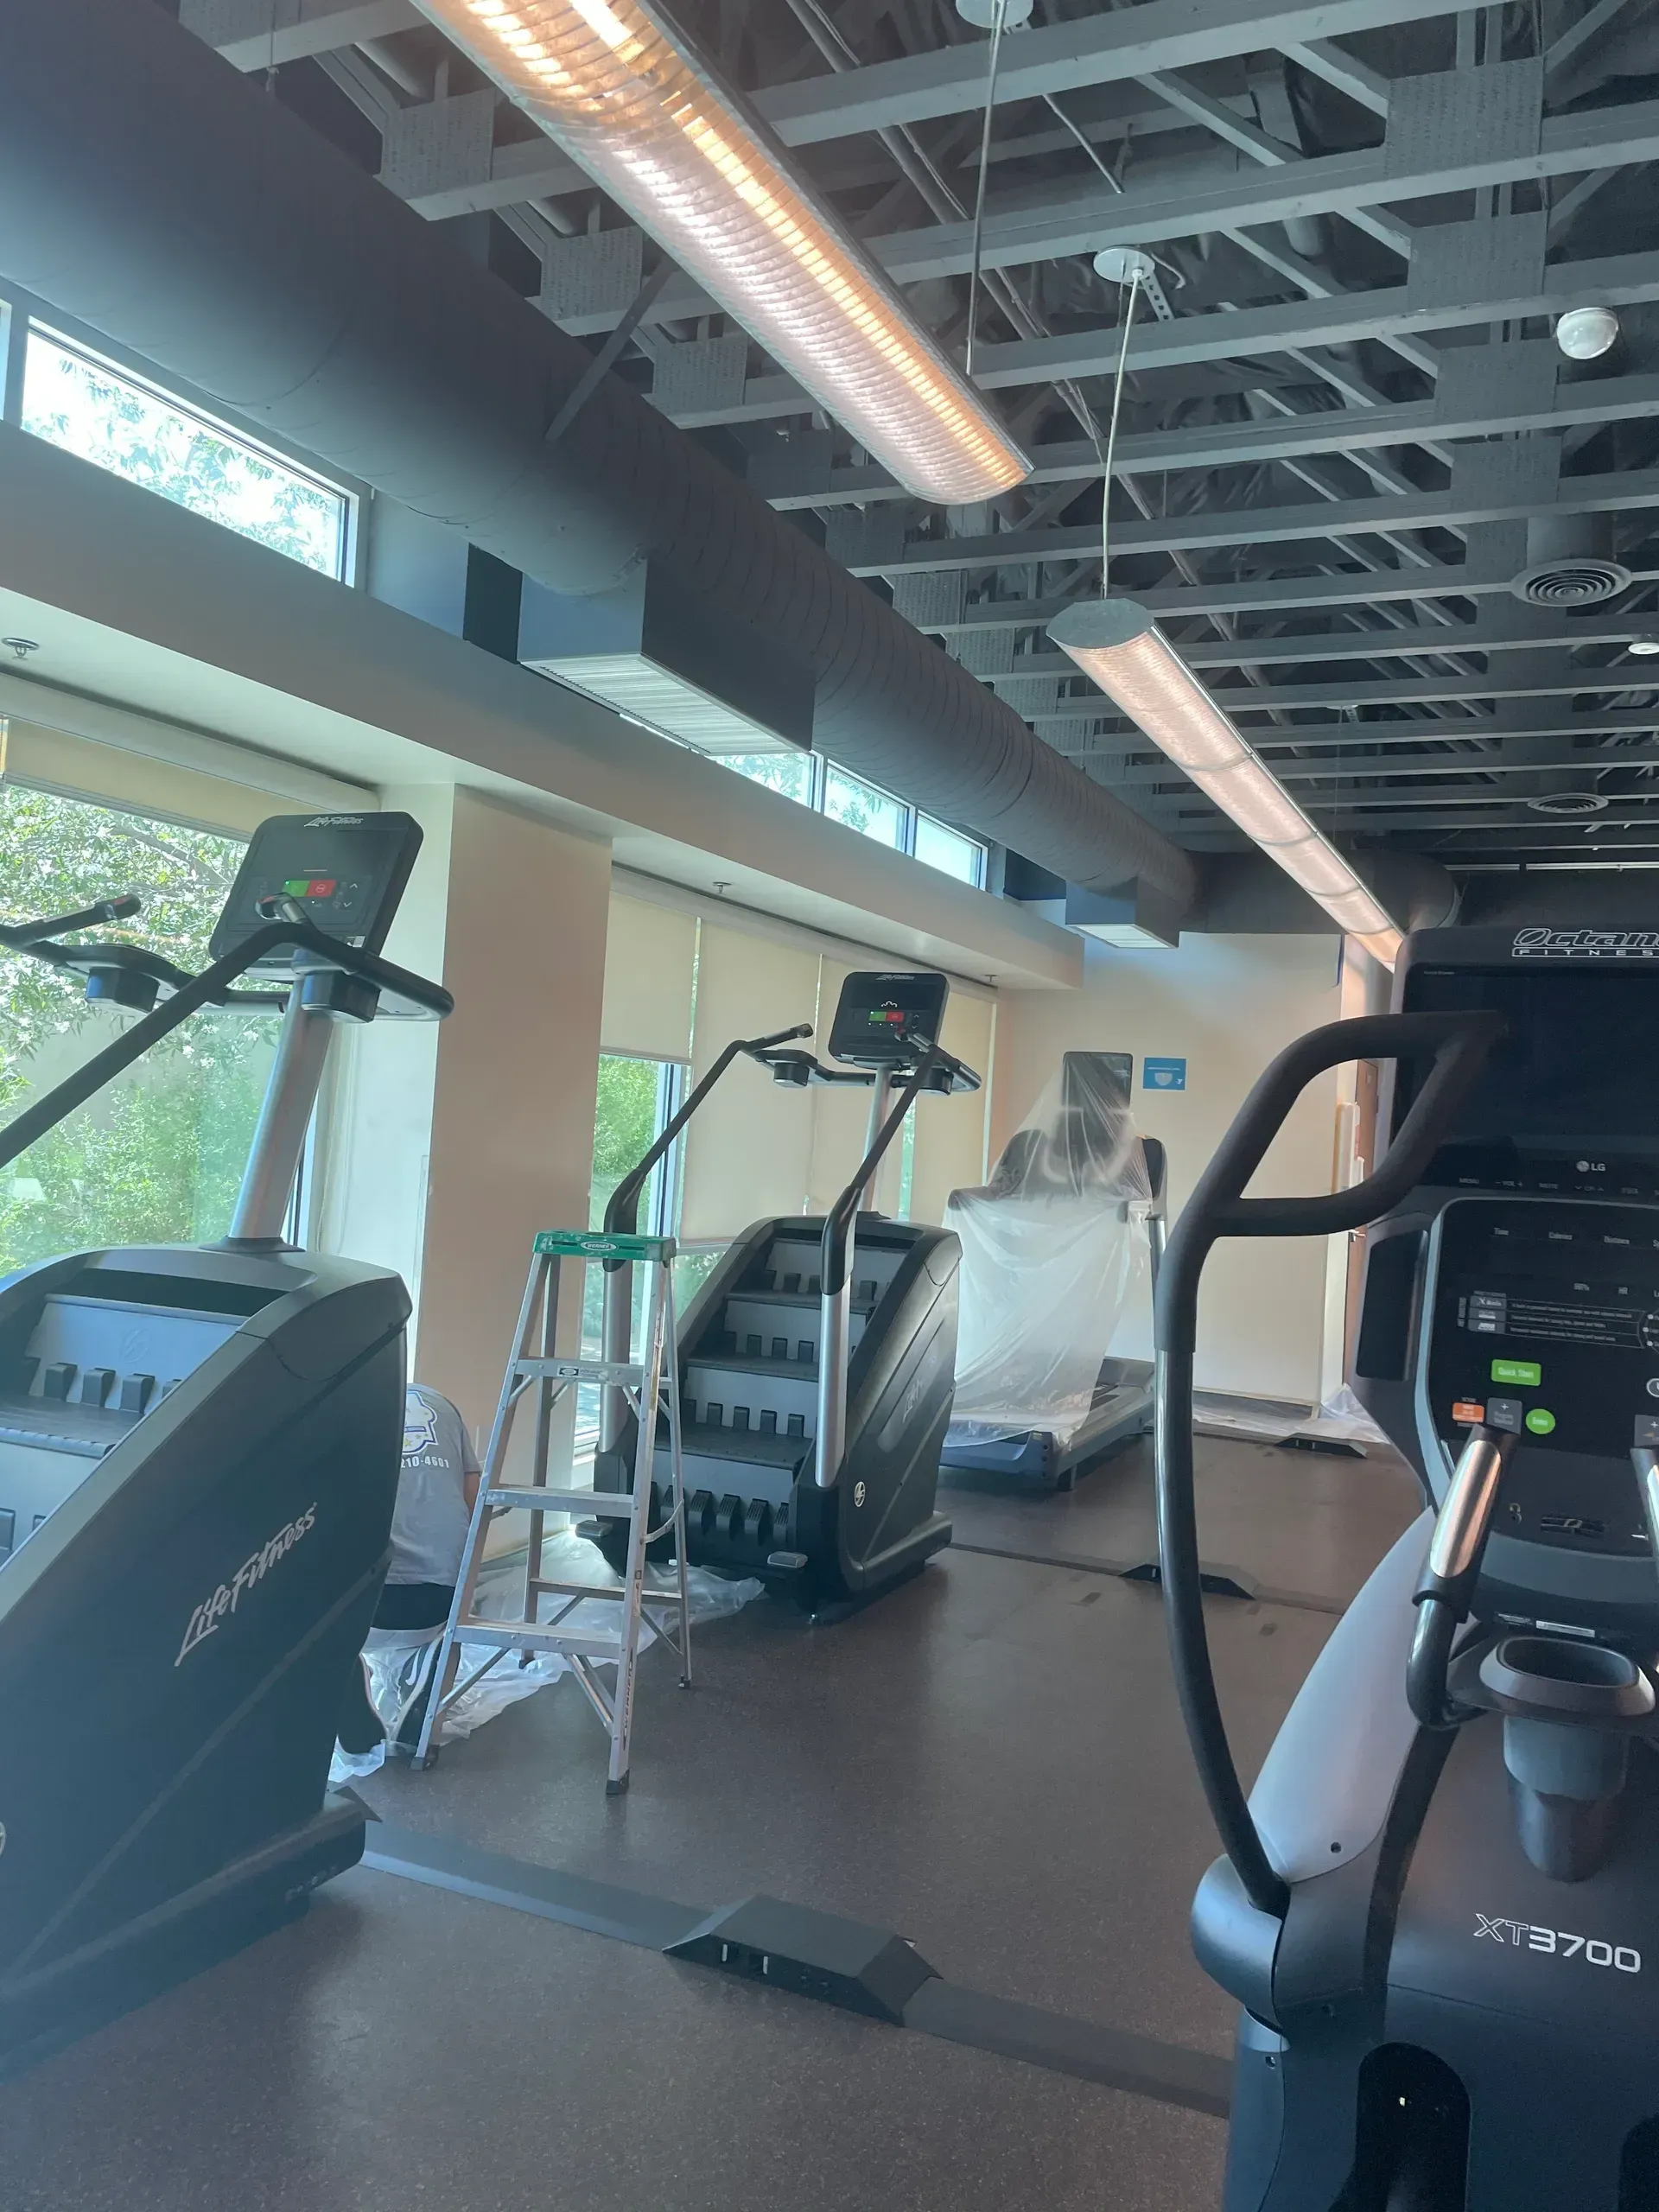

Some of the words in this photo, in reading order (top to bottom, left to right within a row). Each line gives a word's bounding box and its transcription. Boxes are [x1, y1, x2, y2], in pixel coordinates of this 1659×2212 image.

[1513, 927, 1659, 947] Octan
[1591, 1162, 1605, 1171] LG
[1473, 1913, 1641, 1974] XT3700
